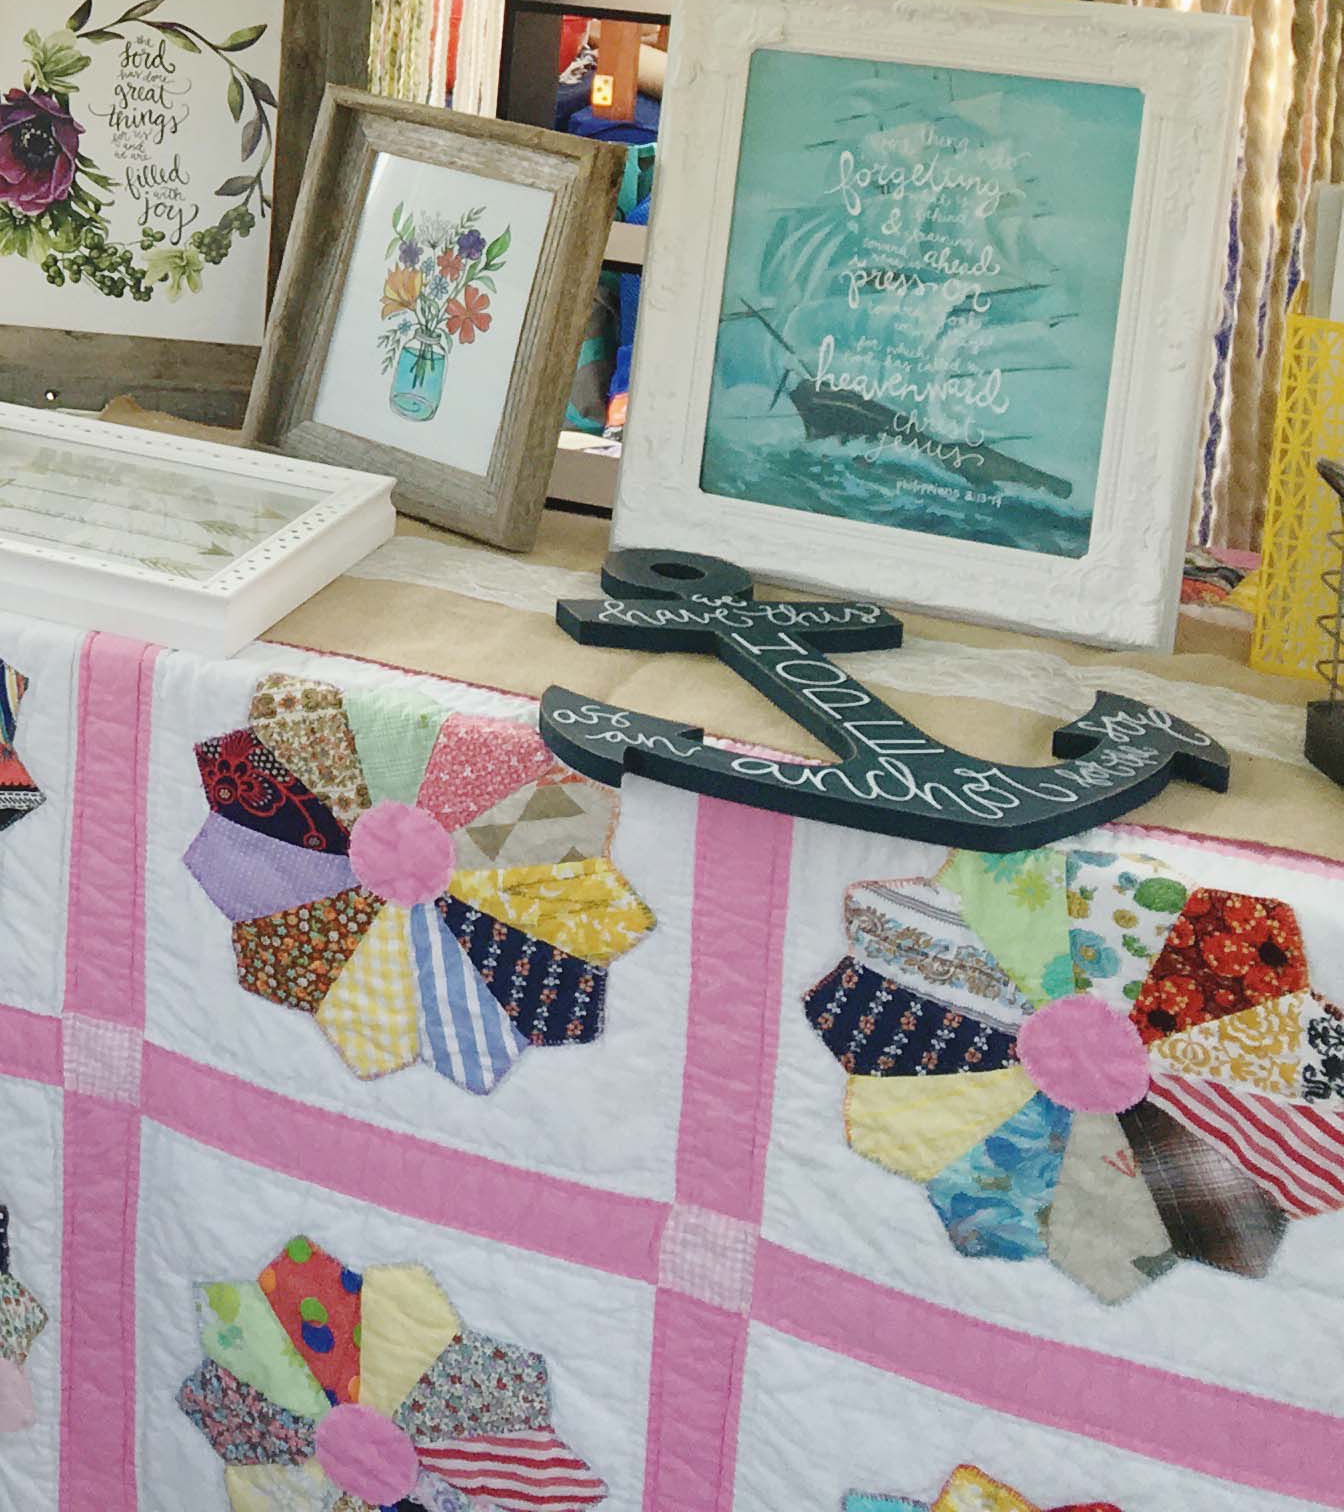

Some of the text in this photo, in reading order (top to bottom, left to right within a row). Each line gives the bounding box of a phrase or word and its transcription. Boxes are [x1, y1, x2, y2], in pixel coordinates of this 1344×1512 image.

[114, 78, 192, 110] great
[88, 104, 190, 145] things
[126, 153, 190, 200] filled
[137, 190, 199, 245] joy
[923, 244, 1001, 276] ahead
[841, 269, 938, 309] press
[809, 334, 1010, 415] heavenward
[598, 600, 882, 628] have this
[691, 593, 748, 608] we
[731, 631, 945, 757] HOPE
[551, 704, 632, 730] as
[1077, 706, 1212, 747] soul
[585, 729, 703, 759] an
[731, 757, 1078, 820] anchor
